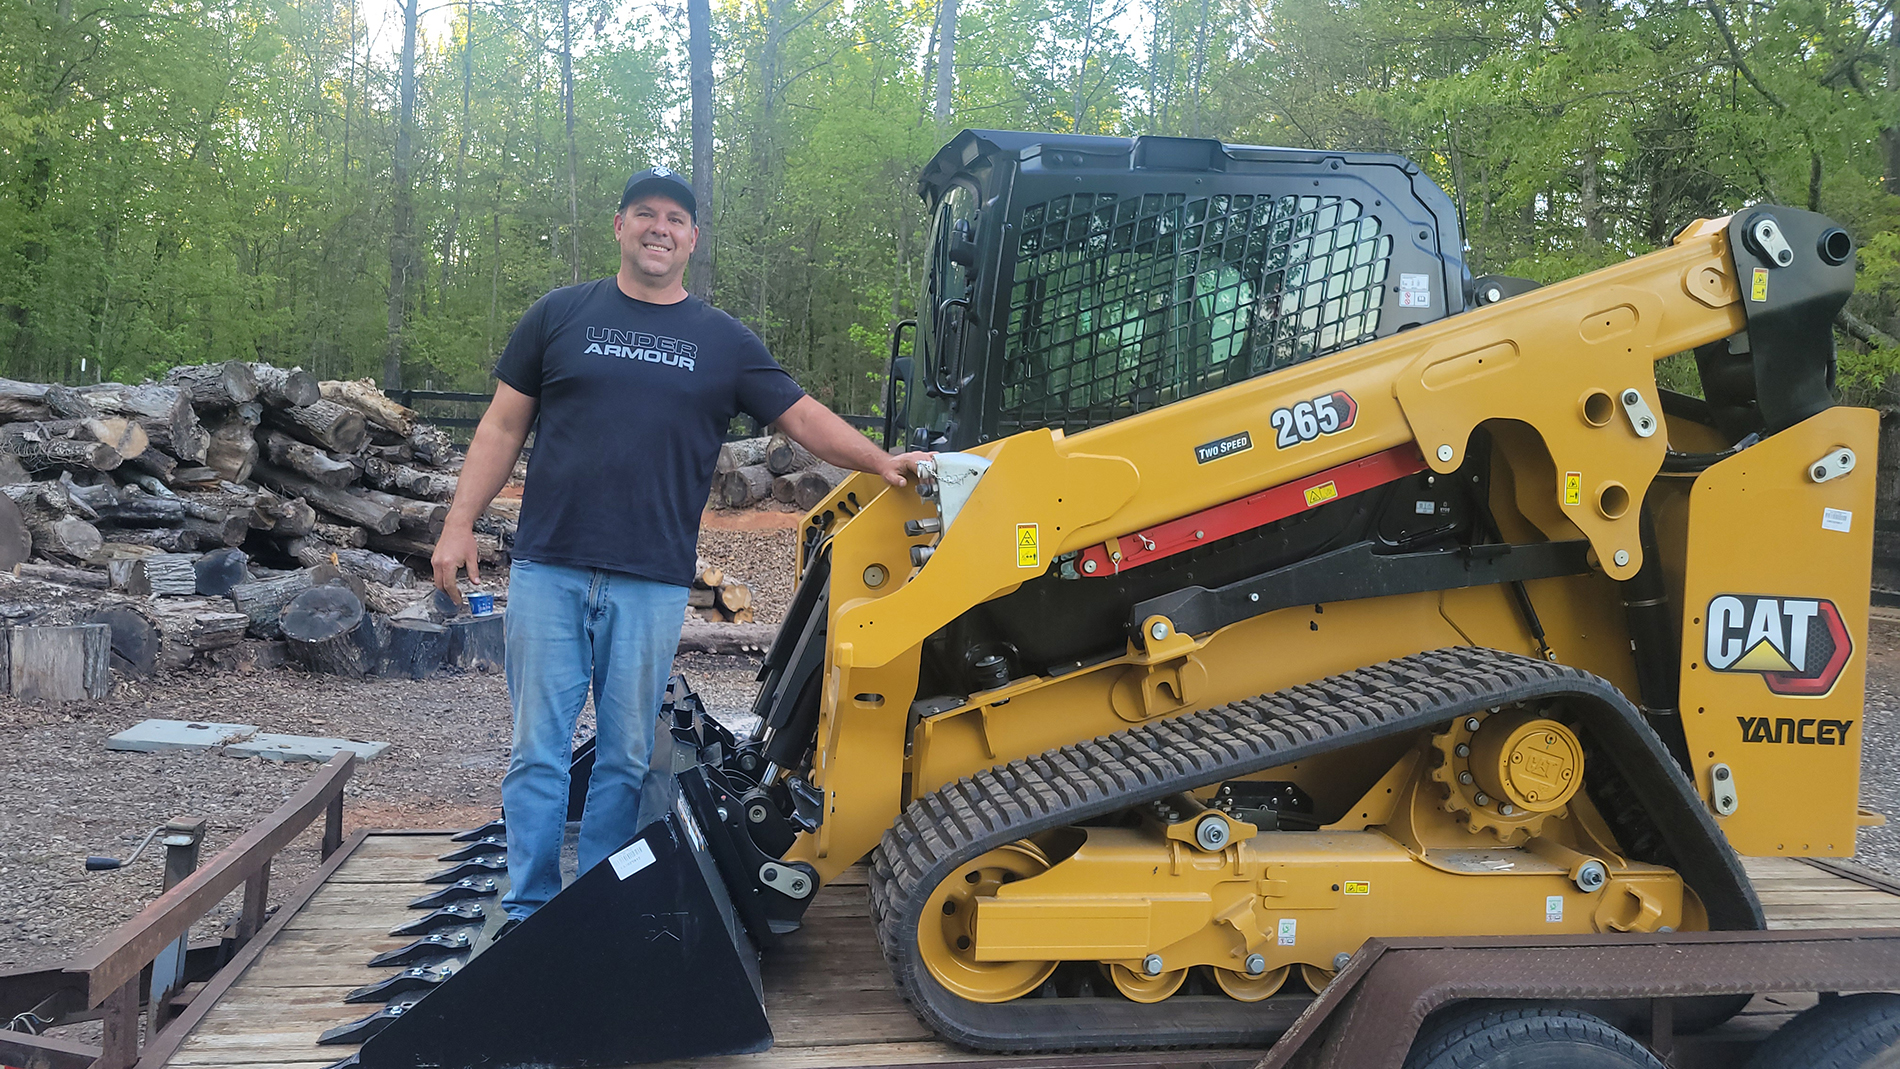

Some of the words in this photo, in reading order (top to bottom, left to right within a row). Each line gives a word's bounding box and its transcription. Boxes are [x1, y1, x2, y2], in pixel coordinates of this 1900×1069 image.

[584, 343, 695, 372] ARMOUR
[586, 326, 698, 359] UNDER
[1272, 395, 1339, 447] 265
[1707, 596, 1818, 672] CAT
[1737, 716, 1853, 745] YANCEY
